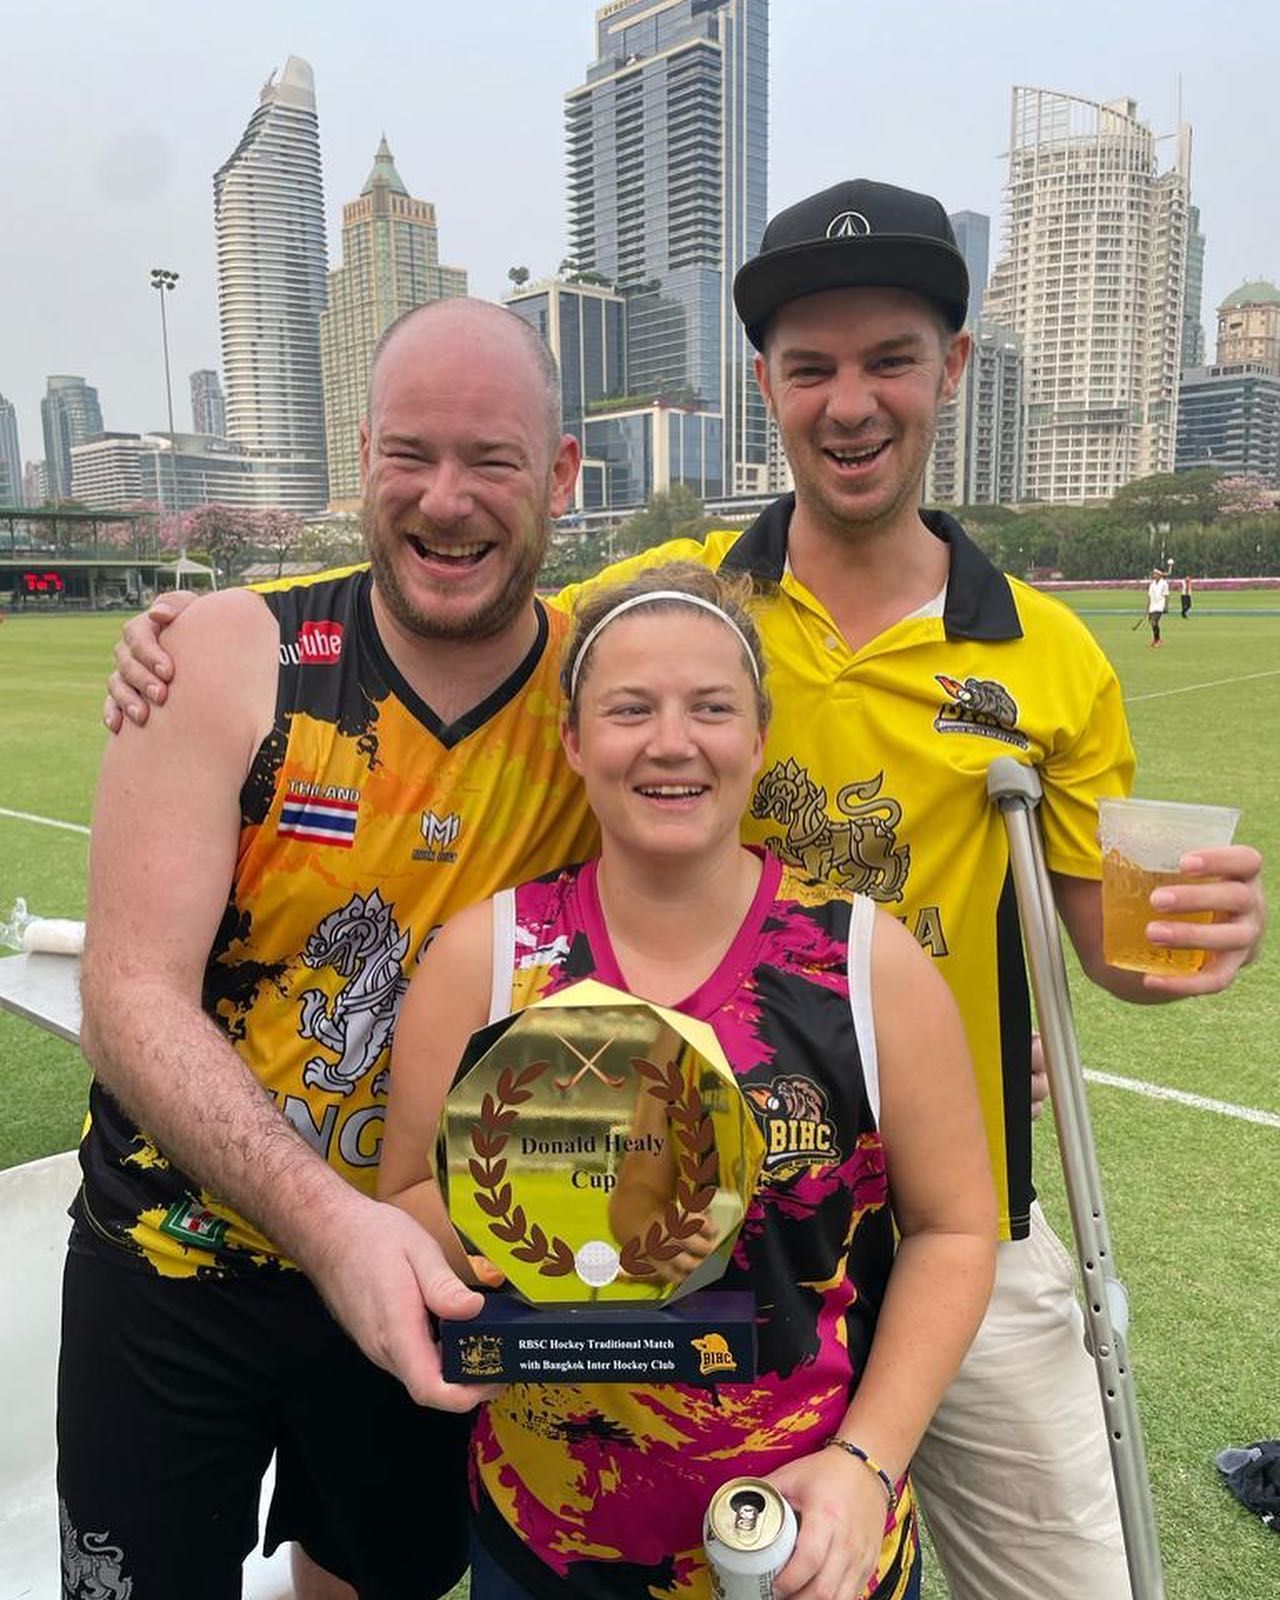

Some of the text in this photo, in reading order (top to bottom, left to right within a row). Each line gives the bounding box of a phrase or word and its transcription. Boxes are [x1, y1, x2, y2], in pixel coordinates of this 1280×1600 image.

[521, 1134, 664, 1156] Donald Healy
[769, 1119, 831, 1154] BIHC
[571, 1169, 616, 1193] Cup
[519, 1339, 675, 1351] RBSC Hockey Traditional Match
[519, 1359, 676, 1372] with Bangkok Inter Hockey Club
